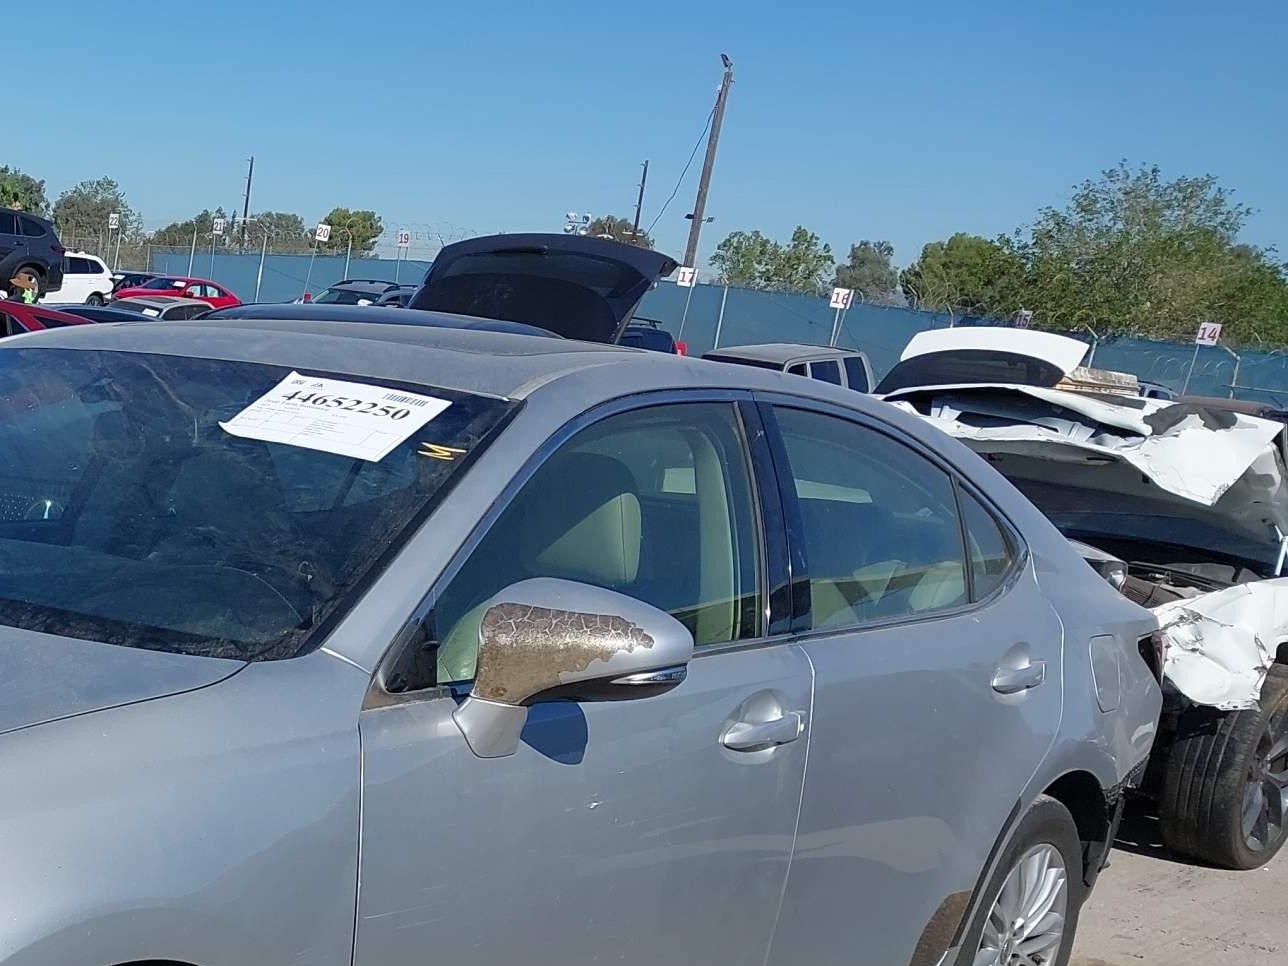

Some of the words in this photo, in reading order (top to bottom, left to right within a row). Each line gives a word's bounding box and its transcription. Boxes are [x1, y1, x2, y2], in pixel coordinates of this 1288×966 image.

[109, 216, 119, 226] 22
[214, 221, 223, 232] 21
[317, 226, 329, 239] 20
[398, 233, 410, 244] 19
[679, 271, 696, 284] 17
[1017, 314, 1031, 327] 15
[1198, 326, 1218, 342] 14
[281, 390, 411, 420] 44652250
